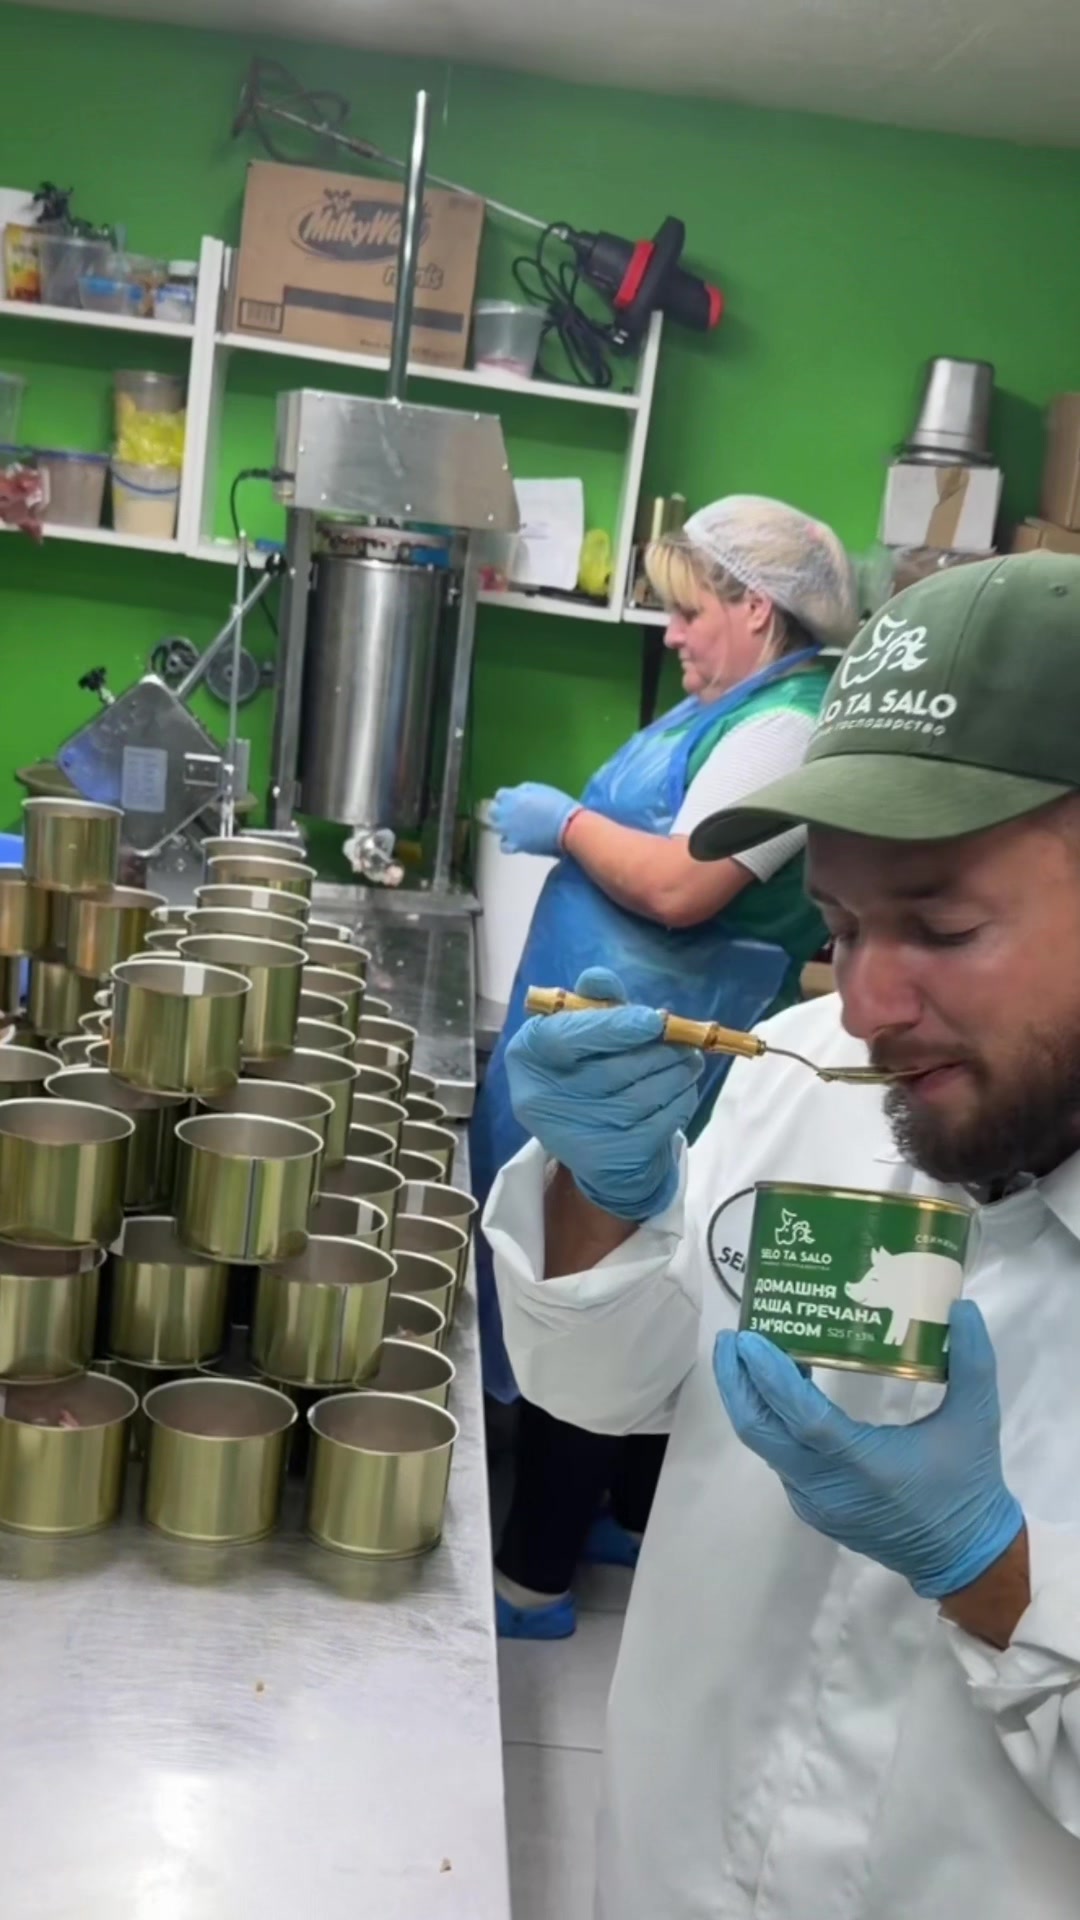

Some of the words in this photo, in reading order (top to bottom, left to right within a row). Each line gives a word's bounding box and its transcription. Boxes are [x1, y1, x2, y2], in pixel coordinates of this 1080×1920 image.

[844, 691, 872, 717] TA
[878, 688, 958, 720] SALO
[761, 1248, 781, 1260] SELO
[783, 1250, 797, 1261] TA
[800, 1251, 832, 1264] SALO
[754, 1278, 837, 1299] ДОМАШНЯ
[753, 1298, 793, 1314] КАША
[797, 1301, 882, 1325] ГРЕЧАНА
[750, 1317, 758, 1330] З
[759, 1318, 822, 1338] М'ЯСОМ
